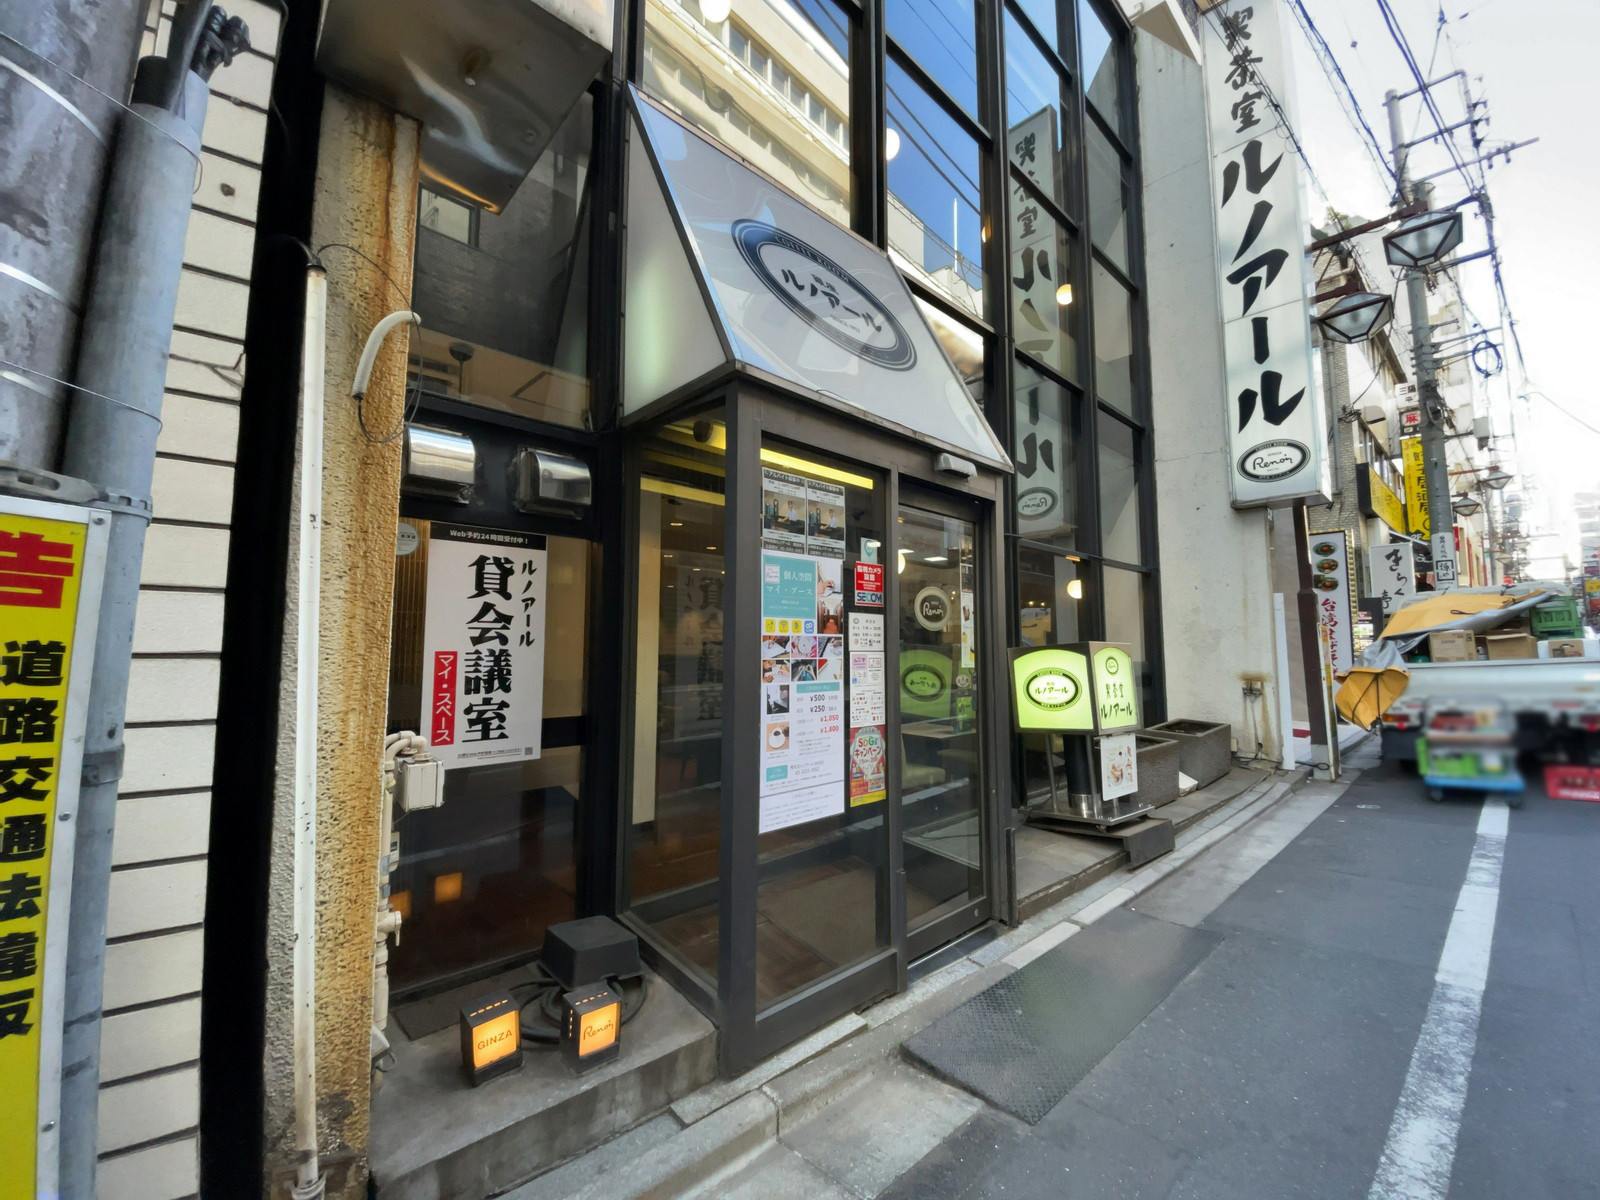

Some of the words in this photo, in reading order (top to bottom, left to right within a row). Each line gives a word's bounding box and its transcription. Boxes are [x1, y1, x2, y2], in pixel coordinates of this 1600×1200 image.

[1221, 6, 1263, 133] 喫茶室
[1221, 139, 1306, 434] ルノアール
[781, 268, 881, 333] ルノアール
[1253, 454, 1293, 470] Renoir
[519, 559, 537, 648] ルノアール
[857, 591, 882, 603] SECOM
[461, 554, 515, 743] 貸会議室
[1034, 686, 1069, 695] ルノアール
[1100, 702, 1133, 719] ルノアール
[477, 1030, 513, 1050] GINZA
[583, 1019, 614, 1041] Renoir
